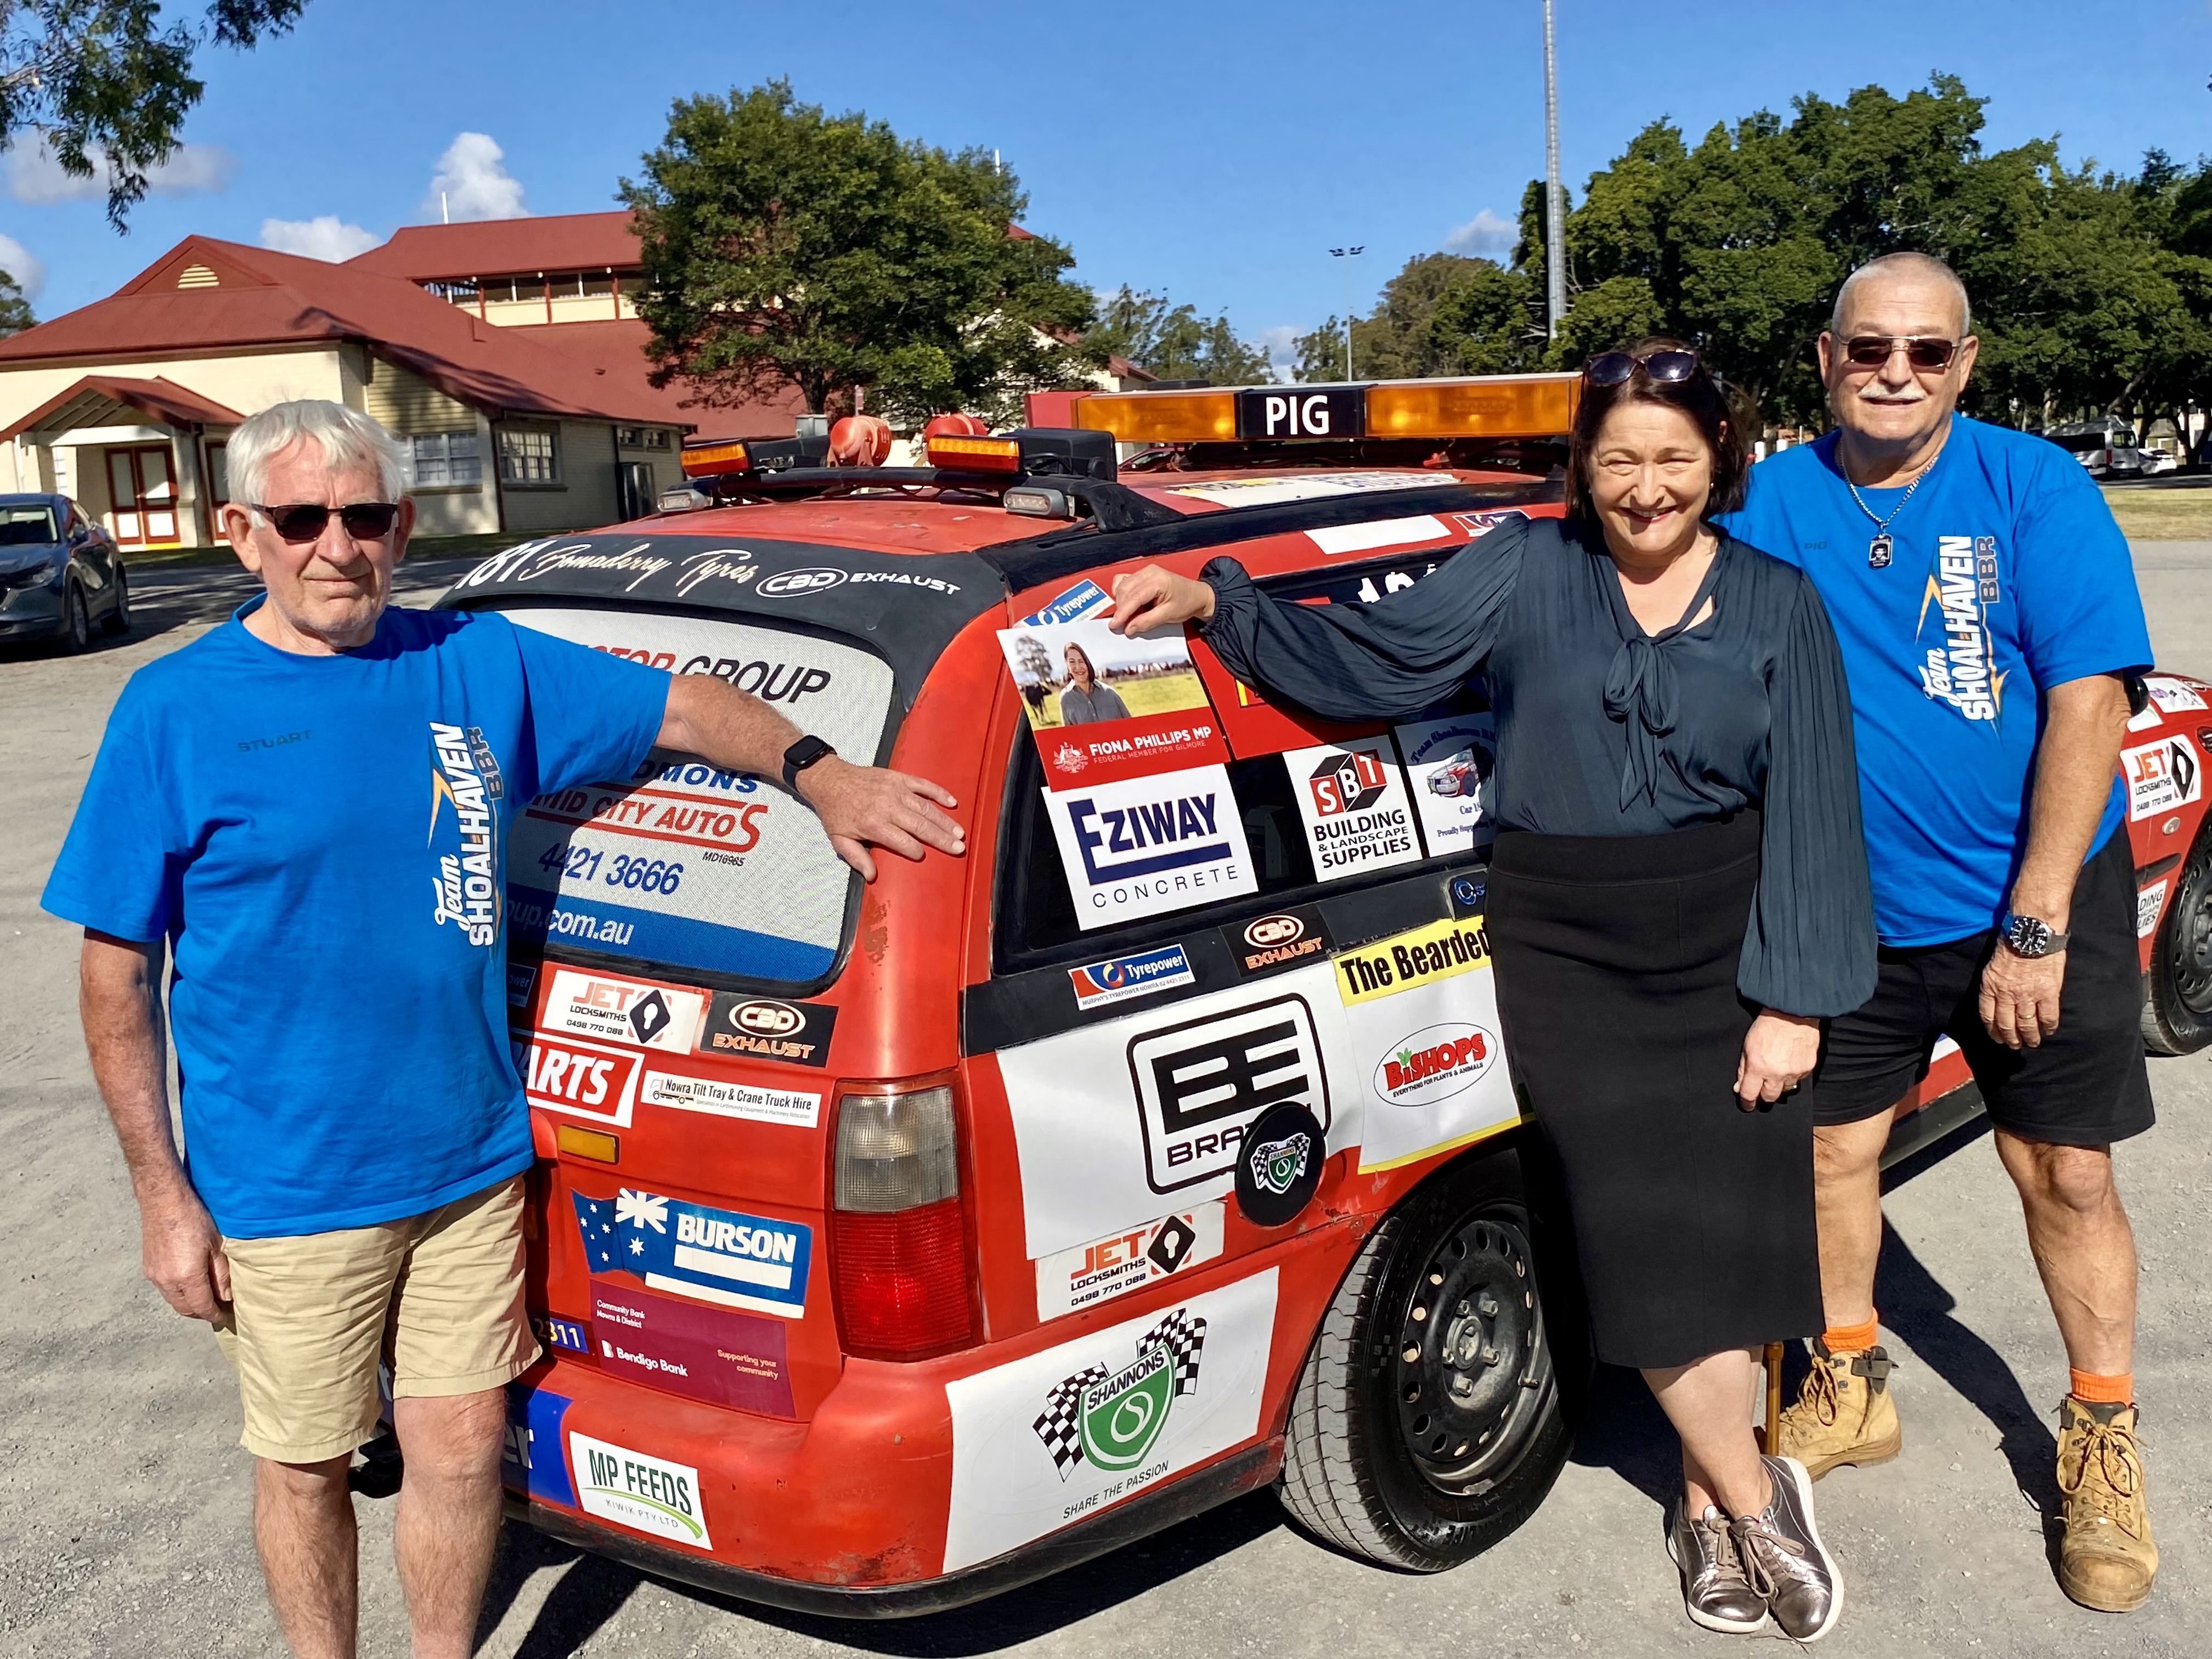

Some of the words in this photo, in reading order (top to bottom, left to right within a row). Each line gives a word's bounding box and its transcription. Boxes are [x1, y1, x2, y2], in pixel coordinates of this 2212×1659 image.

[1266, 396, 1329, 435] PIG
[517, 543, 672, 592] Bomaderry
[675, 549, 759, 597] Tyres
[766, 573, 837, 592] CBD
[850, 573, 961, 595] EXHAUST
[1975, 536, 2000, 604] BBR
[1054, 586, 1099, 617] Tyrepower
[1938, 535, 1996, 720] SHOALHAVEN
[1918, 647, 1962, 707] Team
[238, 730, 312, 753] STUART
[1089, 739, 1133, 756] FIONA
[1134, 730, 1191, 749] PHILLIPS
[1192, 726, 1212, 740] MP
[1093, 754, 1126, 764] FEDERAL
[1128, 749, 1158, 759] MEMBER
[1175, 741, 1206, 751] GILMORE
[466, 726, 504, 800] BBR
[2134, 749, 2166, 783] JET
[1317, 754, 1378, 813] SBT
[592, 795, 655, 824] CITY
[658, 804, 768, 853] AUTOS
[1313, 809, 1406, 842] BUILDING
[1459, 805, 1473, 815] Car
[430, 721, 494, 946] SHOALHAVEN
[1066, 793, 1220, 886] EZIWAY
[1318, 844, 1328, 852] &
[1331, 826, 1409, 849] LANDSCAPE
[1322, 836, 1411, 868] SUPPLIES
[538, 843, 605, 881] 4421
[606, 854, 684, 895] 3666
[432, 853, 472, 932] Team
[1092, 865, 1238, 908] CONCRETE
[1252, 922, 1297, 942] CBD
[1125, 955, 1183, 980] Tyrepower
[1244, 937, 1322, 969] EXHAUST
[1340, 956, 1393, 995] The
[1391, 922, 1492, 981] Bearded
[573, 982, 635, 1011] JET
[1109, 987, 1140, 1001] TYREPOWER
[567, 1019, 588, 1029] 0498
[589, 1024, 604, 1032] 770
[607, 1027, 623, 1035] 088
[570, 1005, 627, 1022] LOCKSMITHS
[740, 1007, 795, 1031] CBD
[713, 1033, 816, 1059] EXHAUST
[665, 1078, 691, 1094] Nowra
[693, 1083, 707, 1097] Tilt
[709, 1086, 726, 1101] Tray
[729, 1088, 734, 1100] &
[737, 1090, 763, 1104] Crane
[765, 1093, 790, 1108] Truck
[792, 1097, 812, 1110] Hire
[1393, 1082, 1423, 1097] EVERYTHING
[1424, 1078, 1434, 1087] FOR
[1434, 1071, 1453, 1084] PLANTS
[1459, 1062, 1483, 1074] ANIMALS
[676, 1213, 797, 1263] BURSON
[1071, 1229, 1146, 1280] JET
[1071, 1257, 1146, 1291] LOCKSMITHS
[1071, 1290, 1099, 1306] 0498
[1103, 1282, 1122, 1295] 770
[1125, 1273, 1146, 1286] 088
[596, 1299, 630, 1316] Community
[630, 1308, 645, 1319] Bank
[596, 1310, 616, 1322] Nowra
[622, 1317, 642, 1329] District
[616, 1347, 658, 1370] Bendigo
[659, 1359, 689, 1377] Bank
[717, 1349, 759, 1366] Supporting
[760, 1359, 777, 1367] your
[736, 1365, 778, 1380] community
[1087, 1351, 1165, 1410] SHANNONS
[588, 1448, 619, 1487] MP
[624, 1460, 692, 1517] FEEDS
[1063, 1493, 1099, 1519] SHARE
[1103, 1482, 1123, 1500] THE
[1126, 1460, 1169, 1489] PASSION
[606, 1499, 635, 1515] KIWIK
[638, 1509, 656, 1521] PTY
[659, 1516, 679, 1528] LTD
